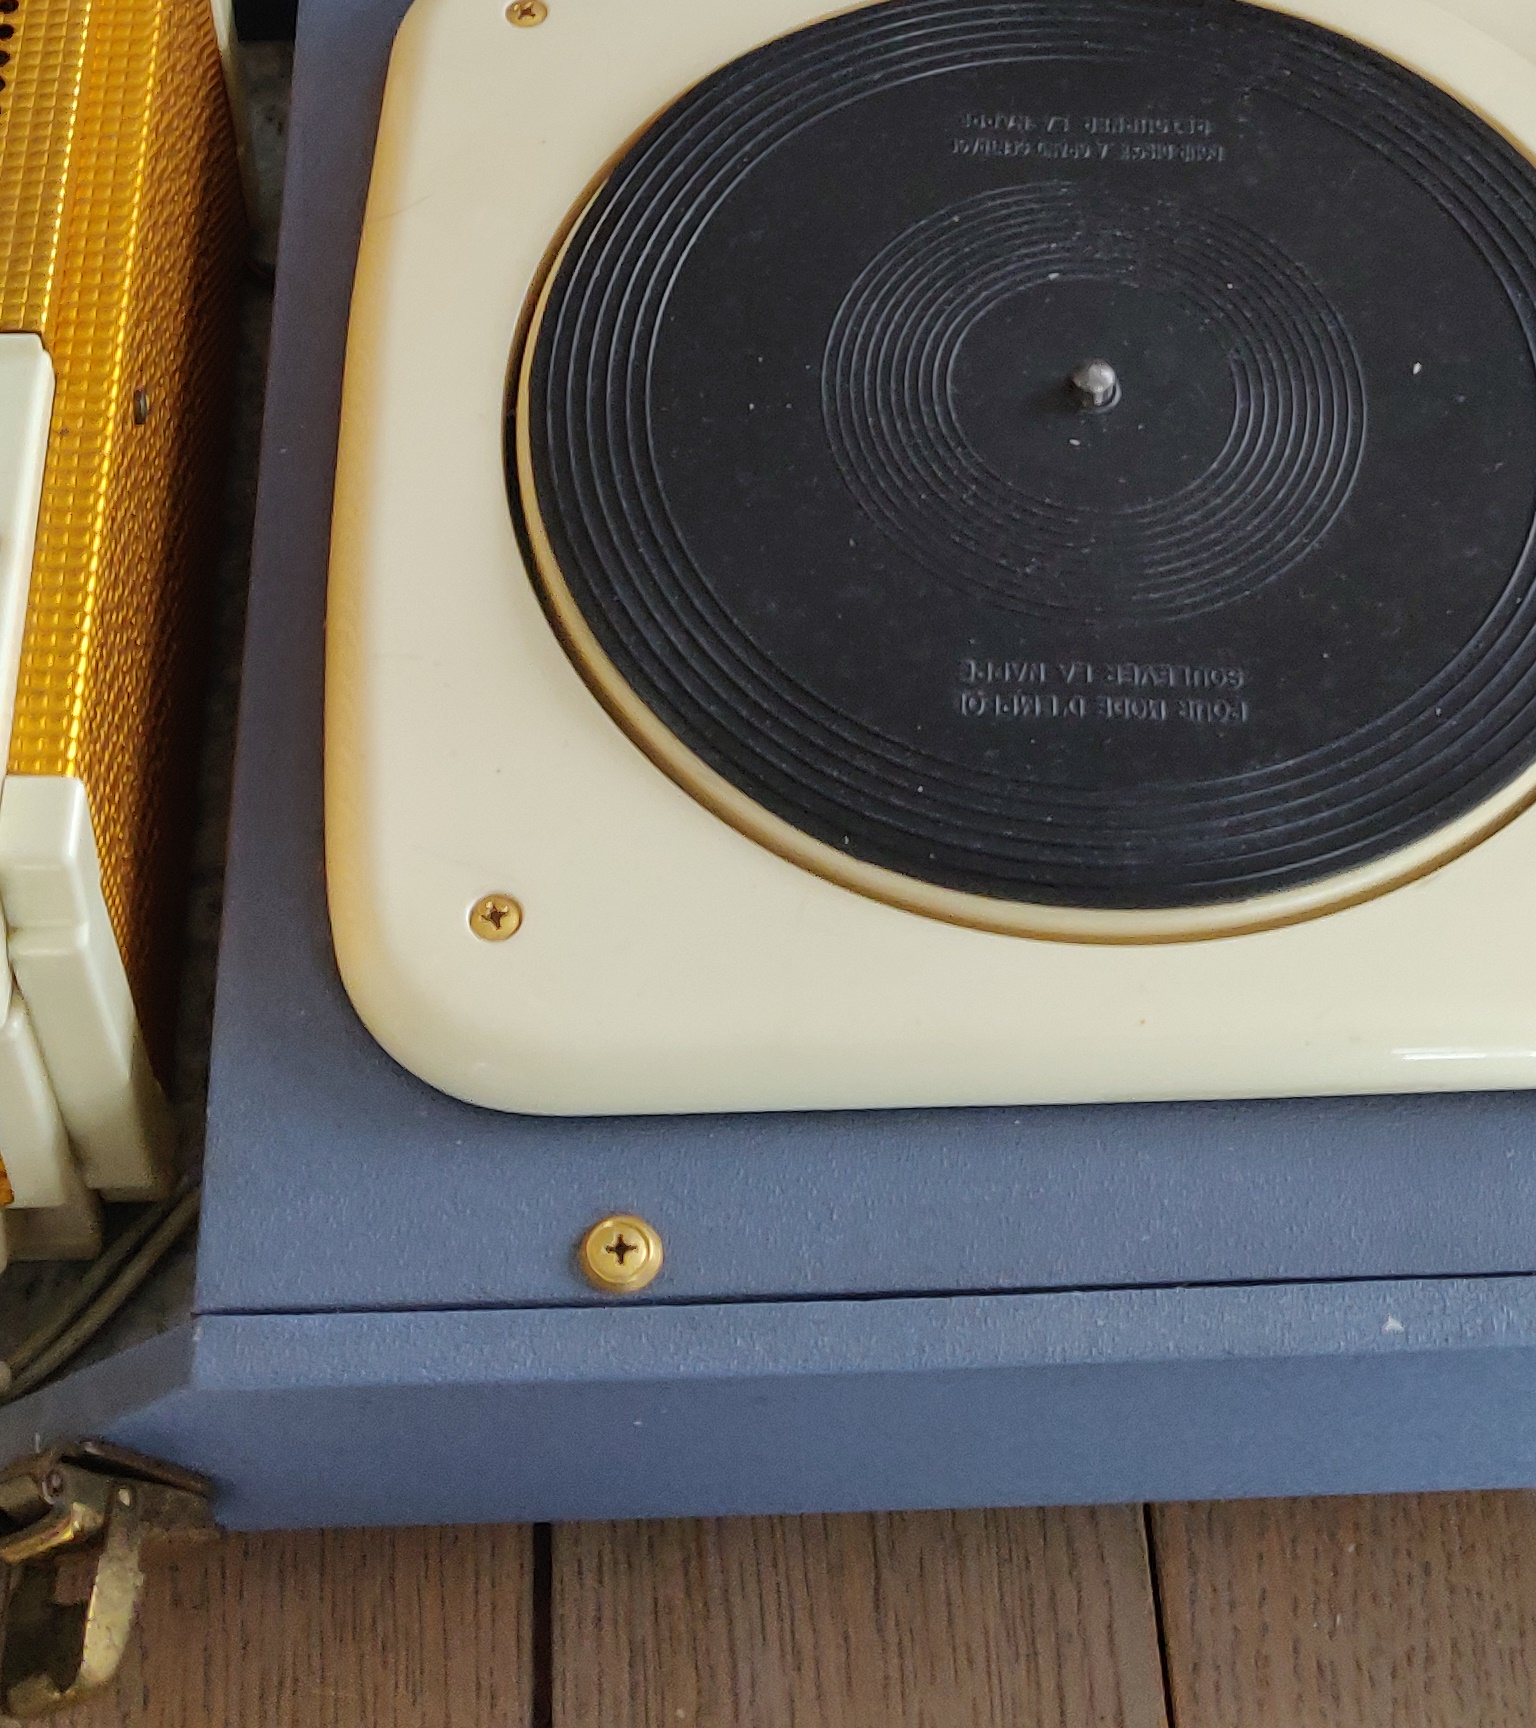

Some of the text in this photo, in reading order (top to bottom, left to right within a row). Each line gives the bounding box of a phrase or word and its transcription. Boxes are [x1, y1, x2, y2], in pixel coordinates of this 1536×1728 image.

[1058, 661, 1094, 686] LA
[1105, 664, 1246, 690] SOULEVER
[1098, 696, 1168, 722] MODE
[1178, 697, 1250, 724] POUR
